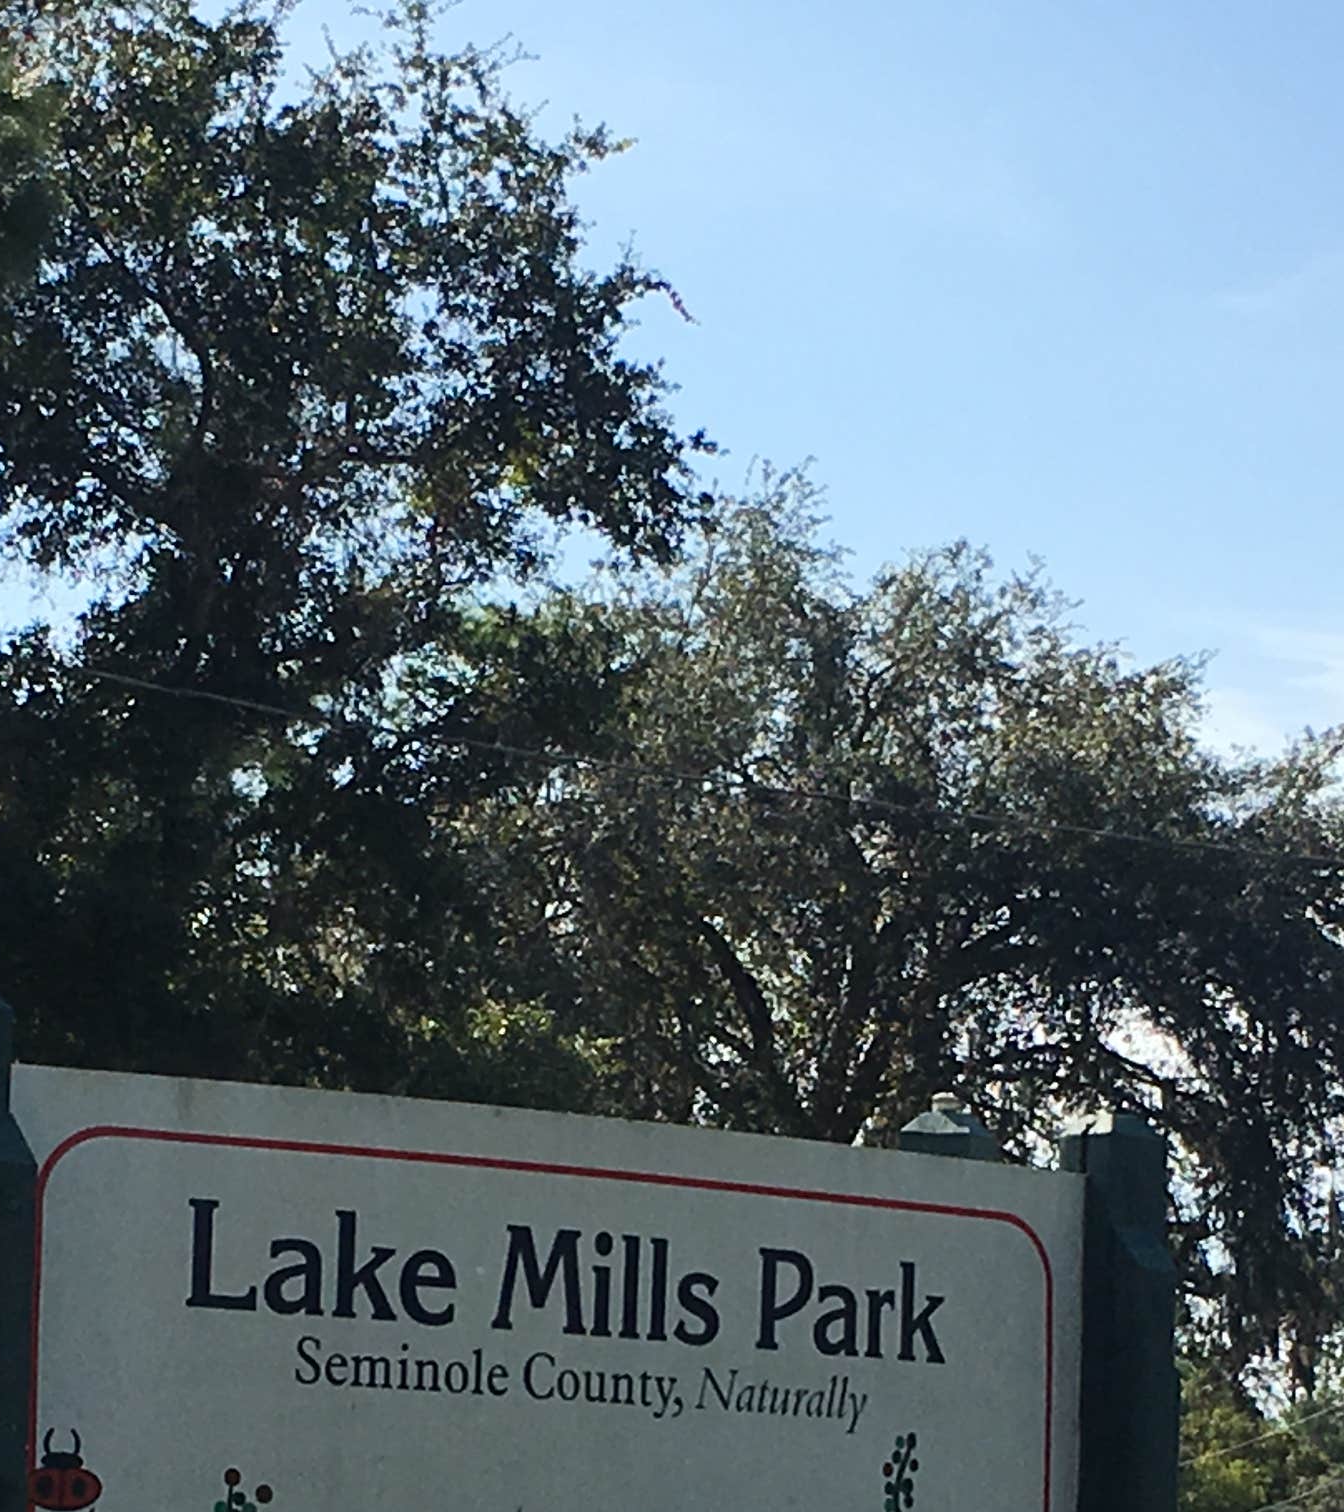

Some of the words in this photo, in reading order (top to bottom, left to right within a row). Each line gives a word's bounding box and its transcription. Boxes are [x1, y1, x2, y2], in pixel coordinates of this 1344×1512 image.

[185, 1198, 457, 1326] Lake
[491, 1224, 720, 1346] Mills
[756, 1247, 946, 1364] Park
[295, 1335, 509, 1396] Seminole
[523, 1352, 684, 1418] County,
[695, 1367, 868, 1434] Naturally
